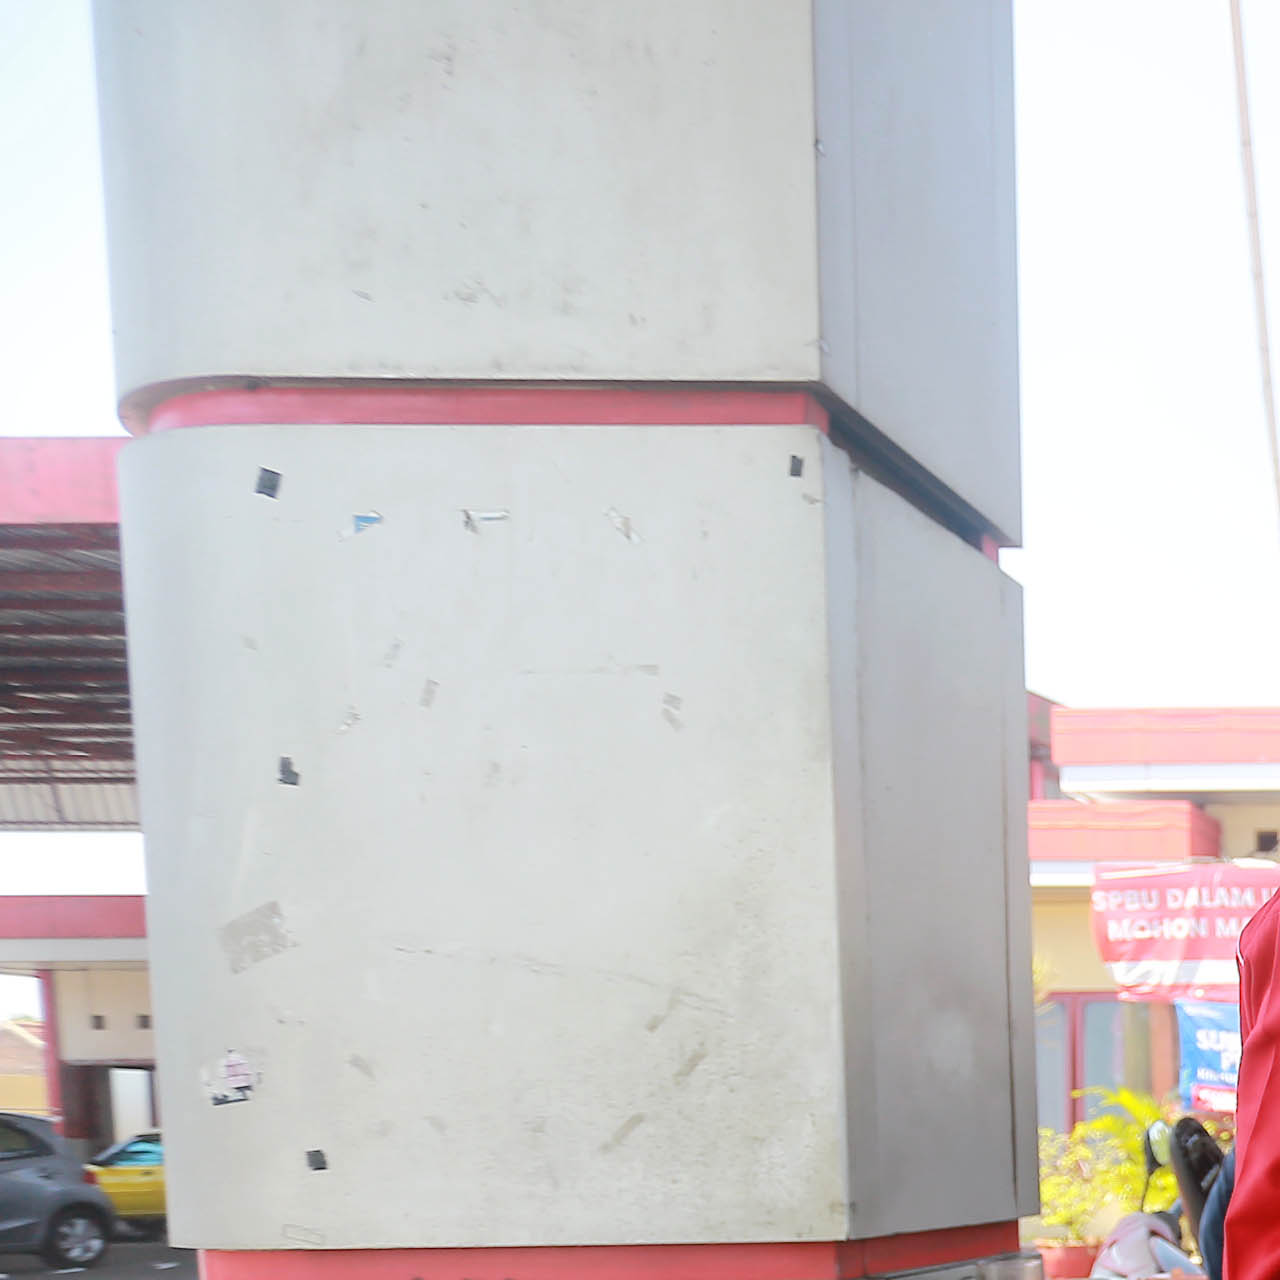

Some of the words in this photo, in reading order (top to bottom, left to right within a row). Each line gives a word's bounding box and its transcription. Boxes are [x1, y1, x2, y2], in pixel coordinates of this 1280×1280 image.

[1091, 890, 1161, 912] SPBU
[1166, 887, 1256, 909] DALAM
[1107, 917, 1208, 941] MOHON
